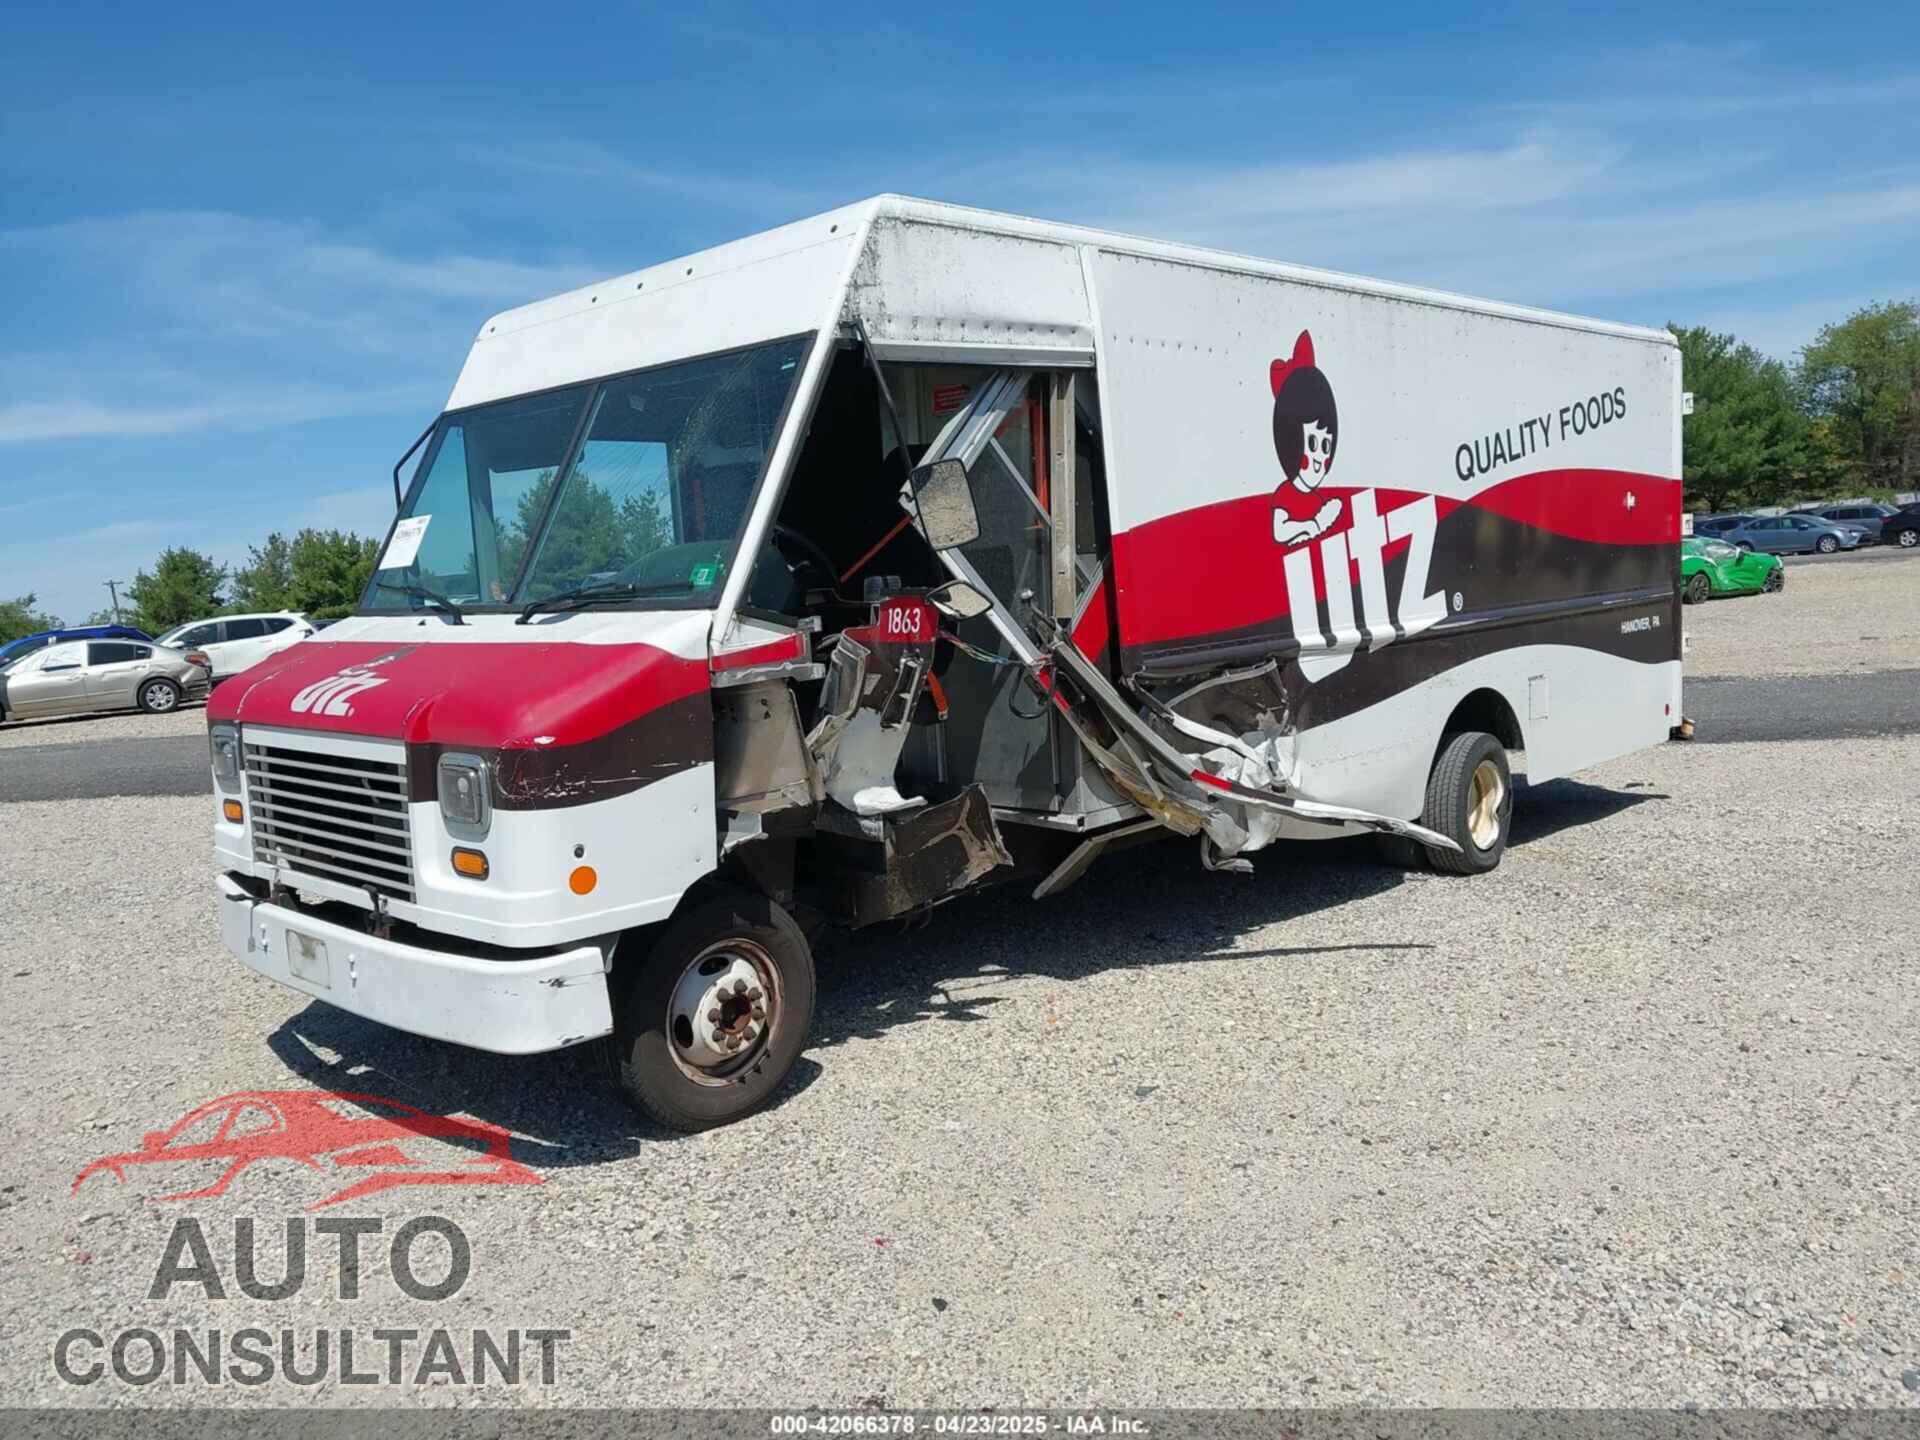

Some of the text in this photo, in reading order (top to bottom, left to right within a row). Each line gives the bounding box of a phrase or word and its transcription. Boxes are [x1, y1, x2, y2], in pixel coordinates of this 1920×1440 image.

[1455, 387, 1626, 481] QUALITY FOODS
[887, 607, 921, 634] 1863
